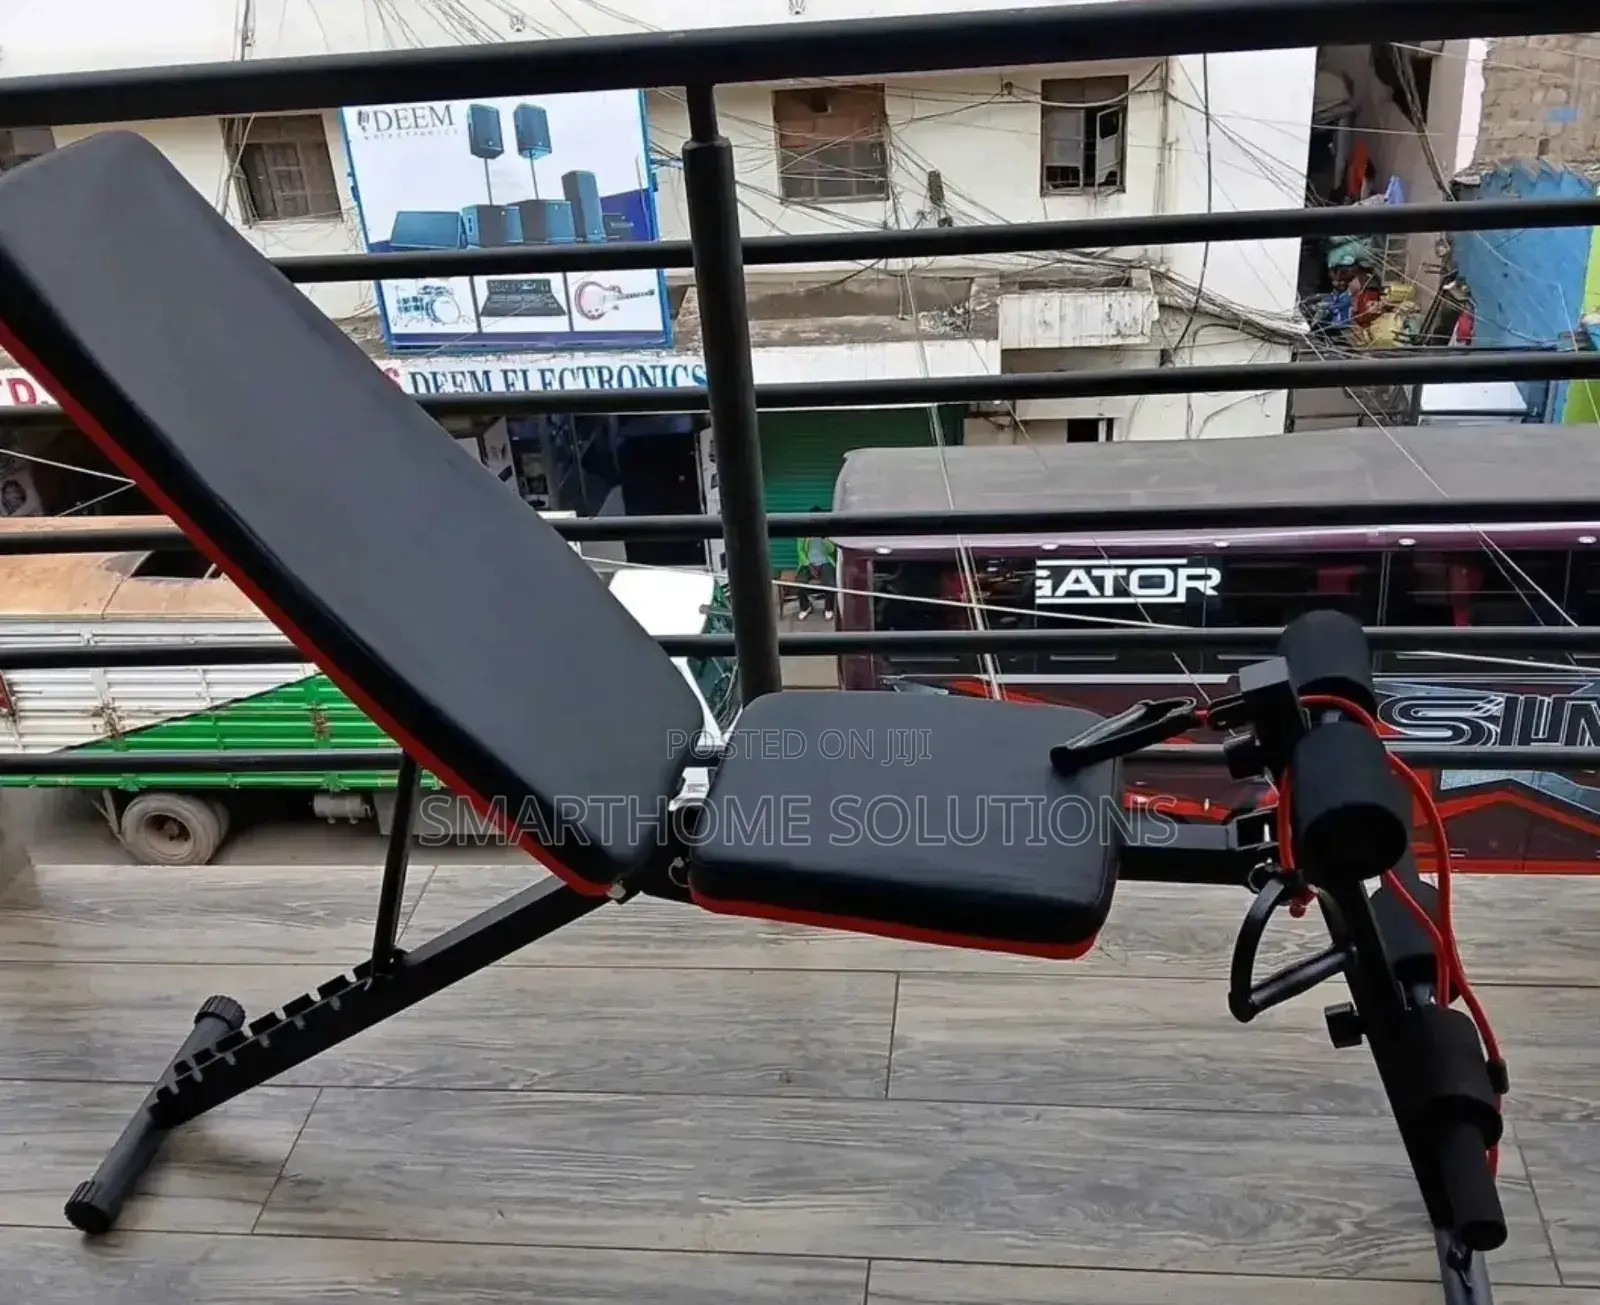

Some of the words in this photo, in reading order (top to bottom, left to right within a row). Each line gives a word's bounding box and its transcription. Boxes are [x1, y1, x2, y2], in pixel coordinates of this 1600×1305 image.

[371, 103, 454, 132] DEEM
[408, 369, 493, 394] DEEM
[501, 363, 707, 391] ELECTRONICS
